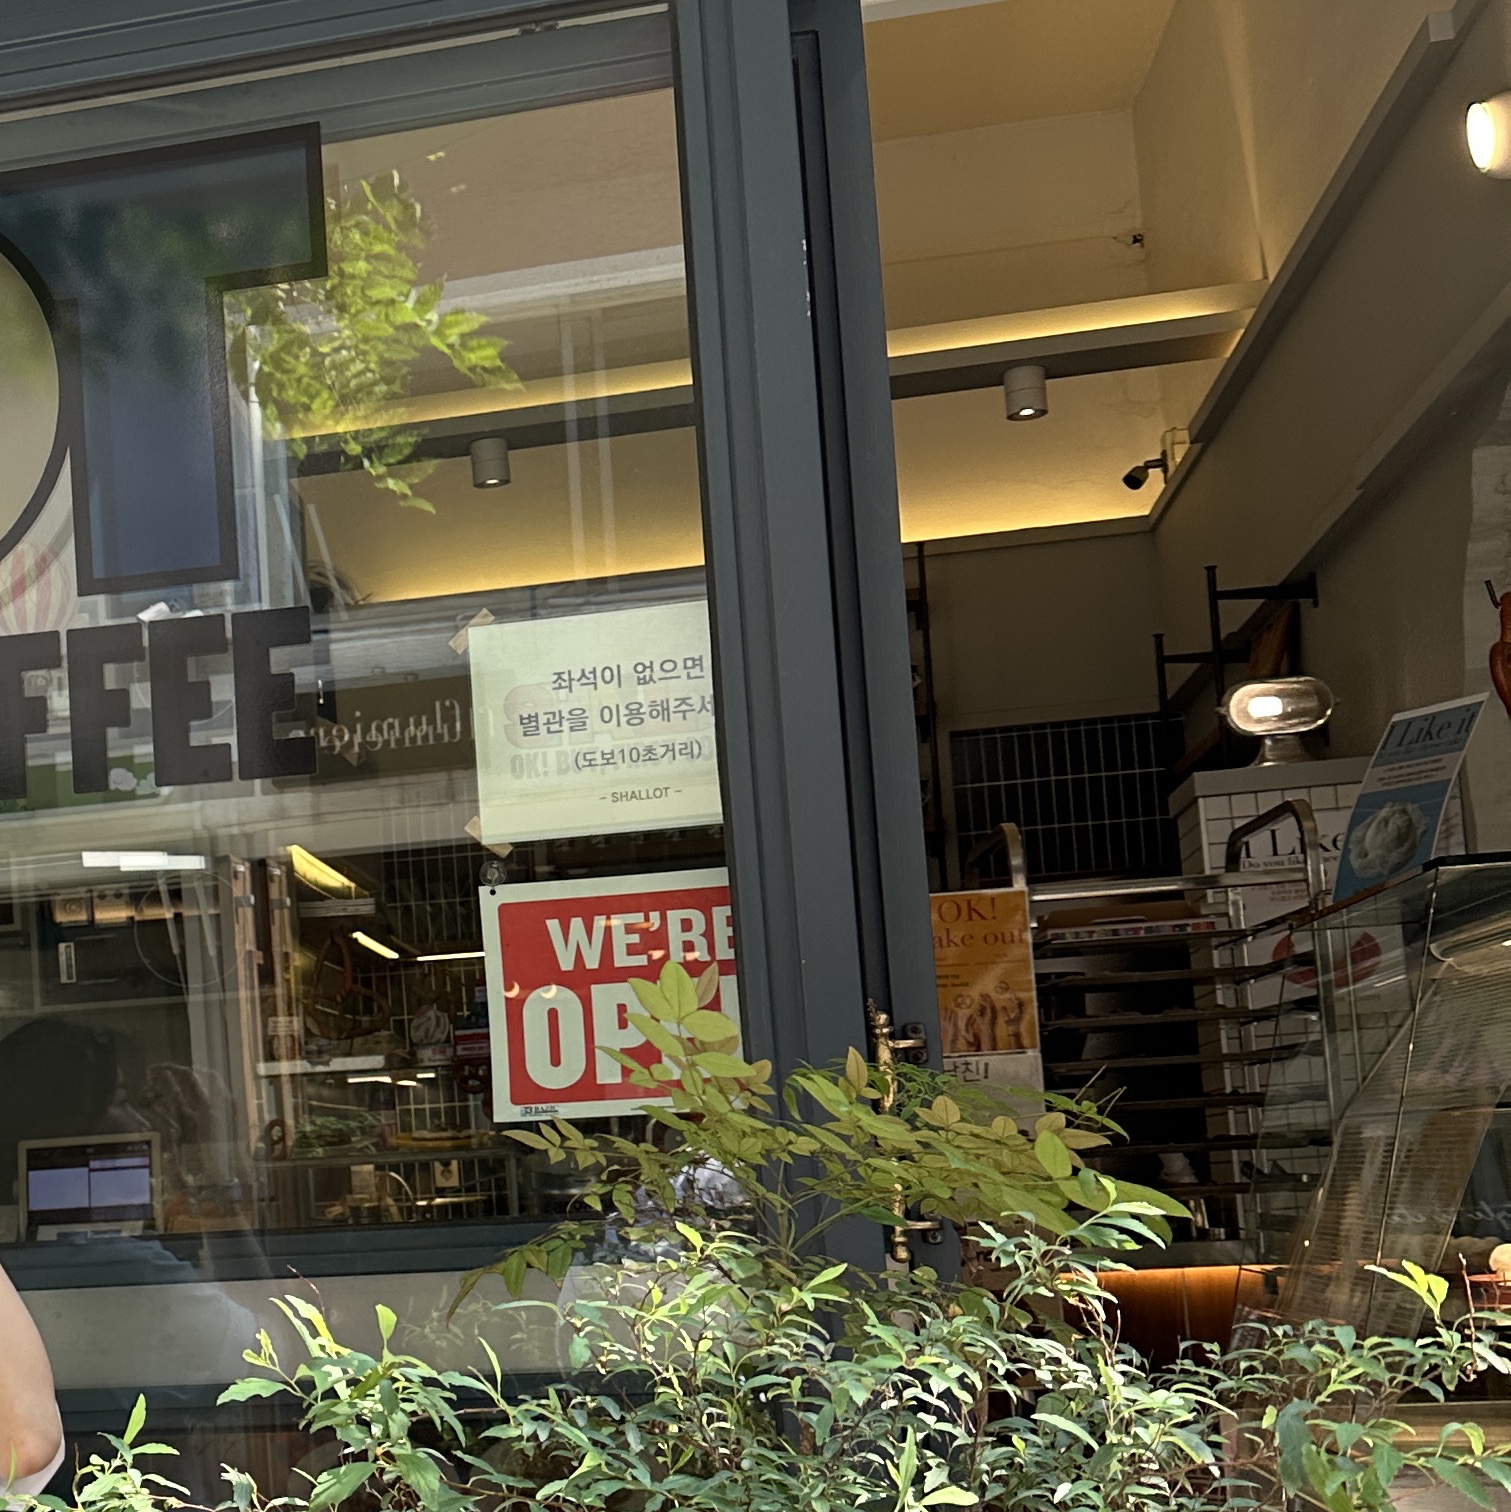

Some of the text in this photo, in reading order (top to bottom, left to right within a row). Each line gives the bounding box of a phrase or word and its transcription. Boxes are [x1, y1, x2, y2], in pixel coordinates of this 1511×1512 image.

[551, 655, 706, 694] 좌석이 없으면
[518, 707, 590, 738] 별관을
[1395, 715, 1452, 748] Like
[574, 740, 703, 771] (도보10초거리)
[610, 787, 671, 803] SHALLOT
[937, 896, 997, 924] OK!
[545, 904, 736, 972] WE'RE
[933, 928, 974, 948] ake
